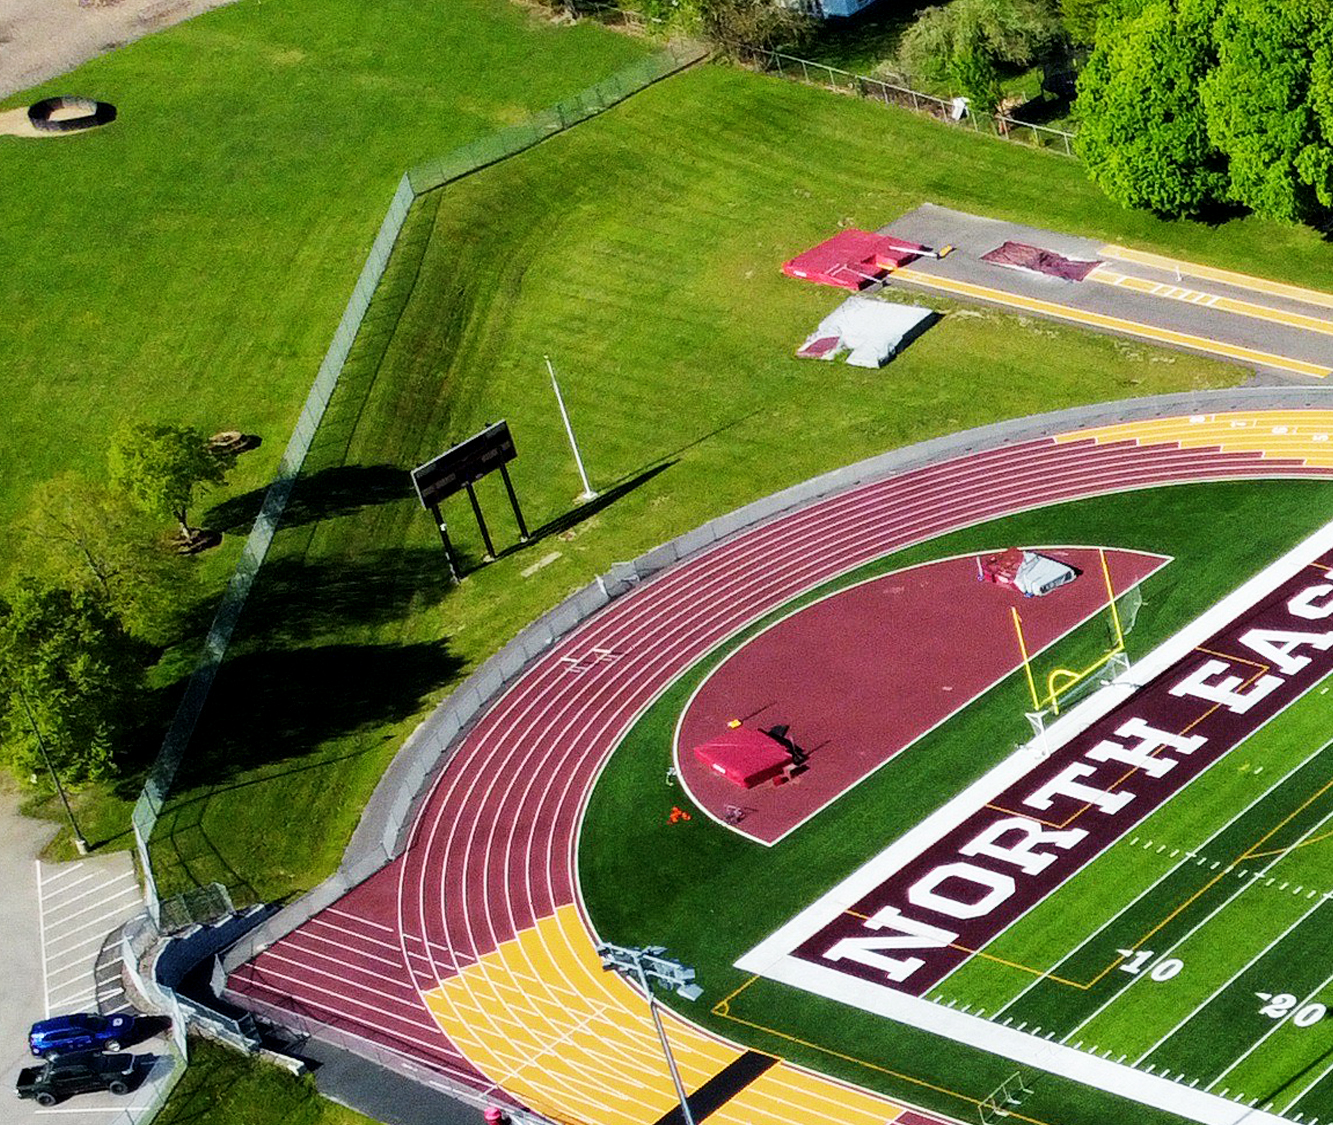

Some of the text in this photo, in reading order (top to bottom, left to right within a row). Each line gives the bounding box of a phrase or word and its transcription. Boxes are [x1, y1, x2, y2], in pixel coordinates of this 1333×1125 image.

[821, 717, 1209, 984] NORTH
[1120, 951, 1184, 982] 10
[1259, 994, 1327, 1027] 20
